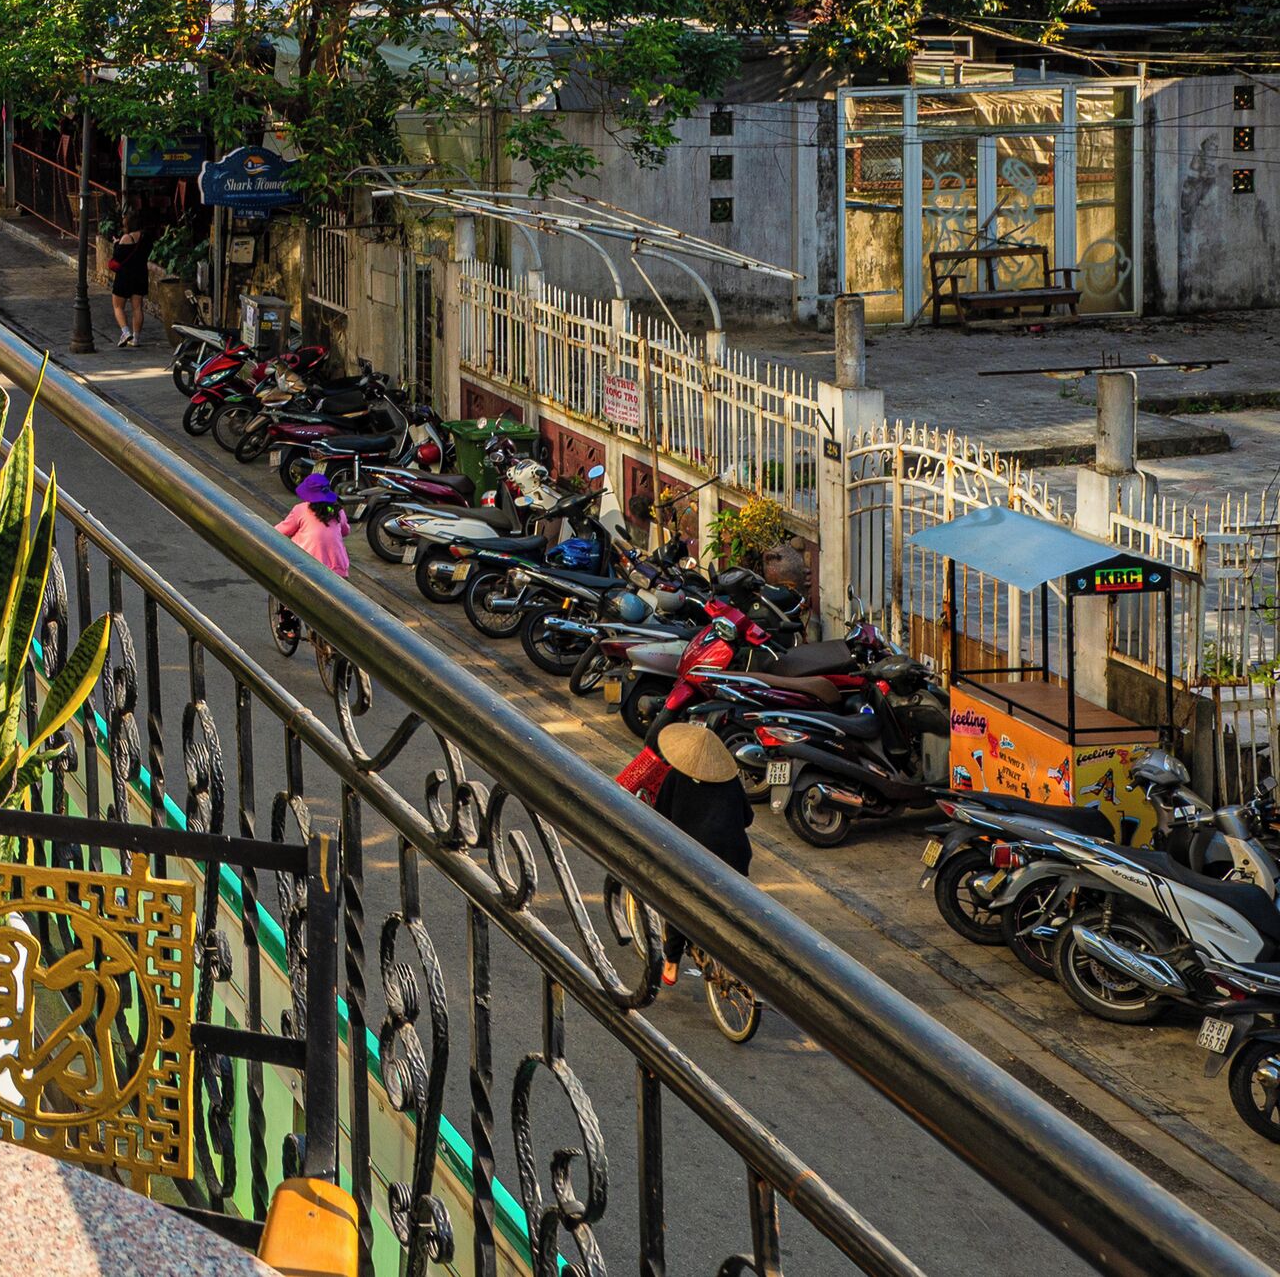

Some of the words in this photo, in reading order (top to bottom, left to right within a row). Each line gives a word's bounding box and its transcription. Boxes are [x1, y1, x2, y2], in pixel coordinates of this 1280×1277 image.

[224, 178, 252, 192] Shark
[1100, 570, 1138, 586] KBC
[952, 708, 986, 734] feeling
[1076, 748, 1116, 766] feeling
[769, 774, 787, 784] 2665
[1121, 874, 1148, 888] adidas
